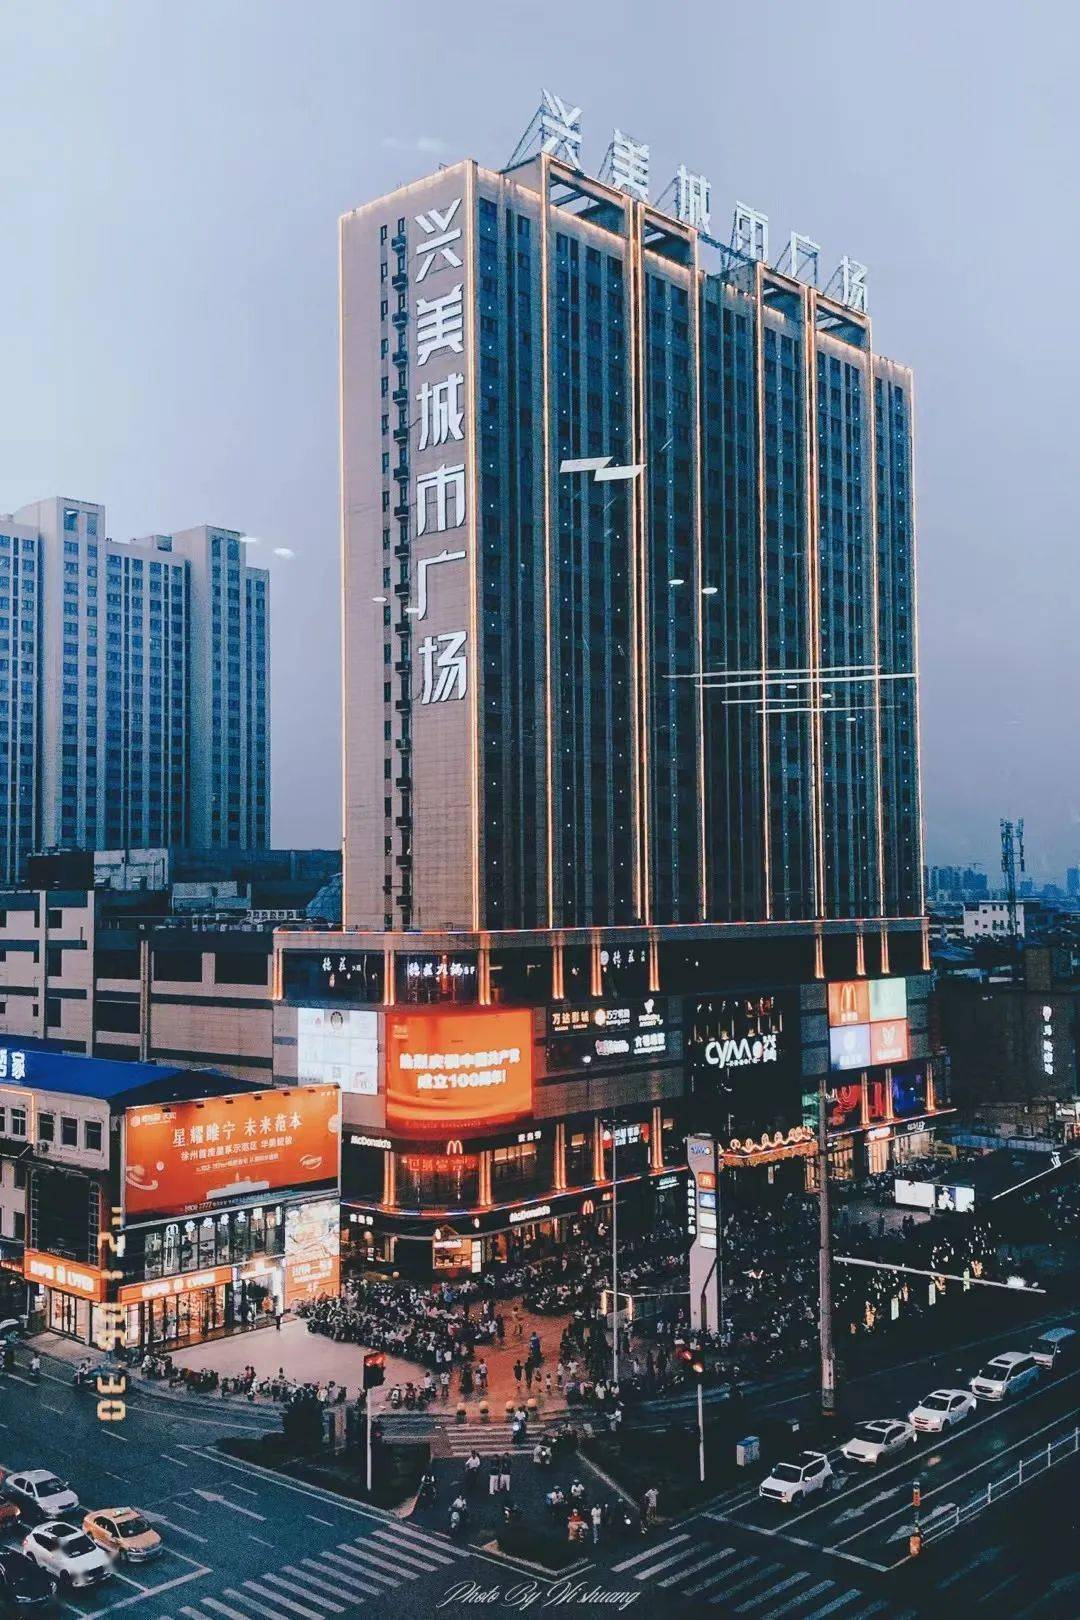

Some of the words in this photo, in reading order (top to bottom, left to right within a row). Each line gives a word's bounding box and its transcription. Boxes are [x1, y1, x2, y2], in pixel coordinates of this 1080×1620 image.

[541, 88, 868, 314] 兴美城市广场
[415, 198, 468, 705] 兴美城市广场
